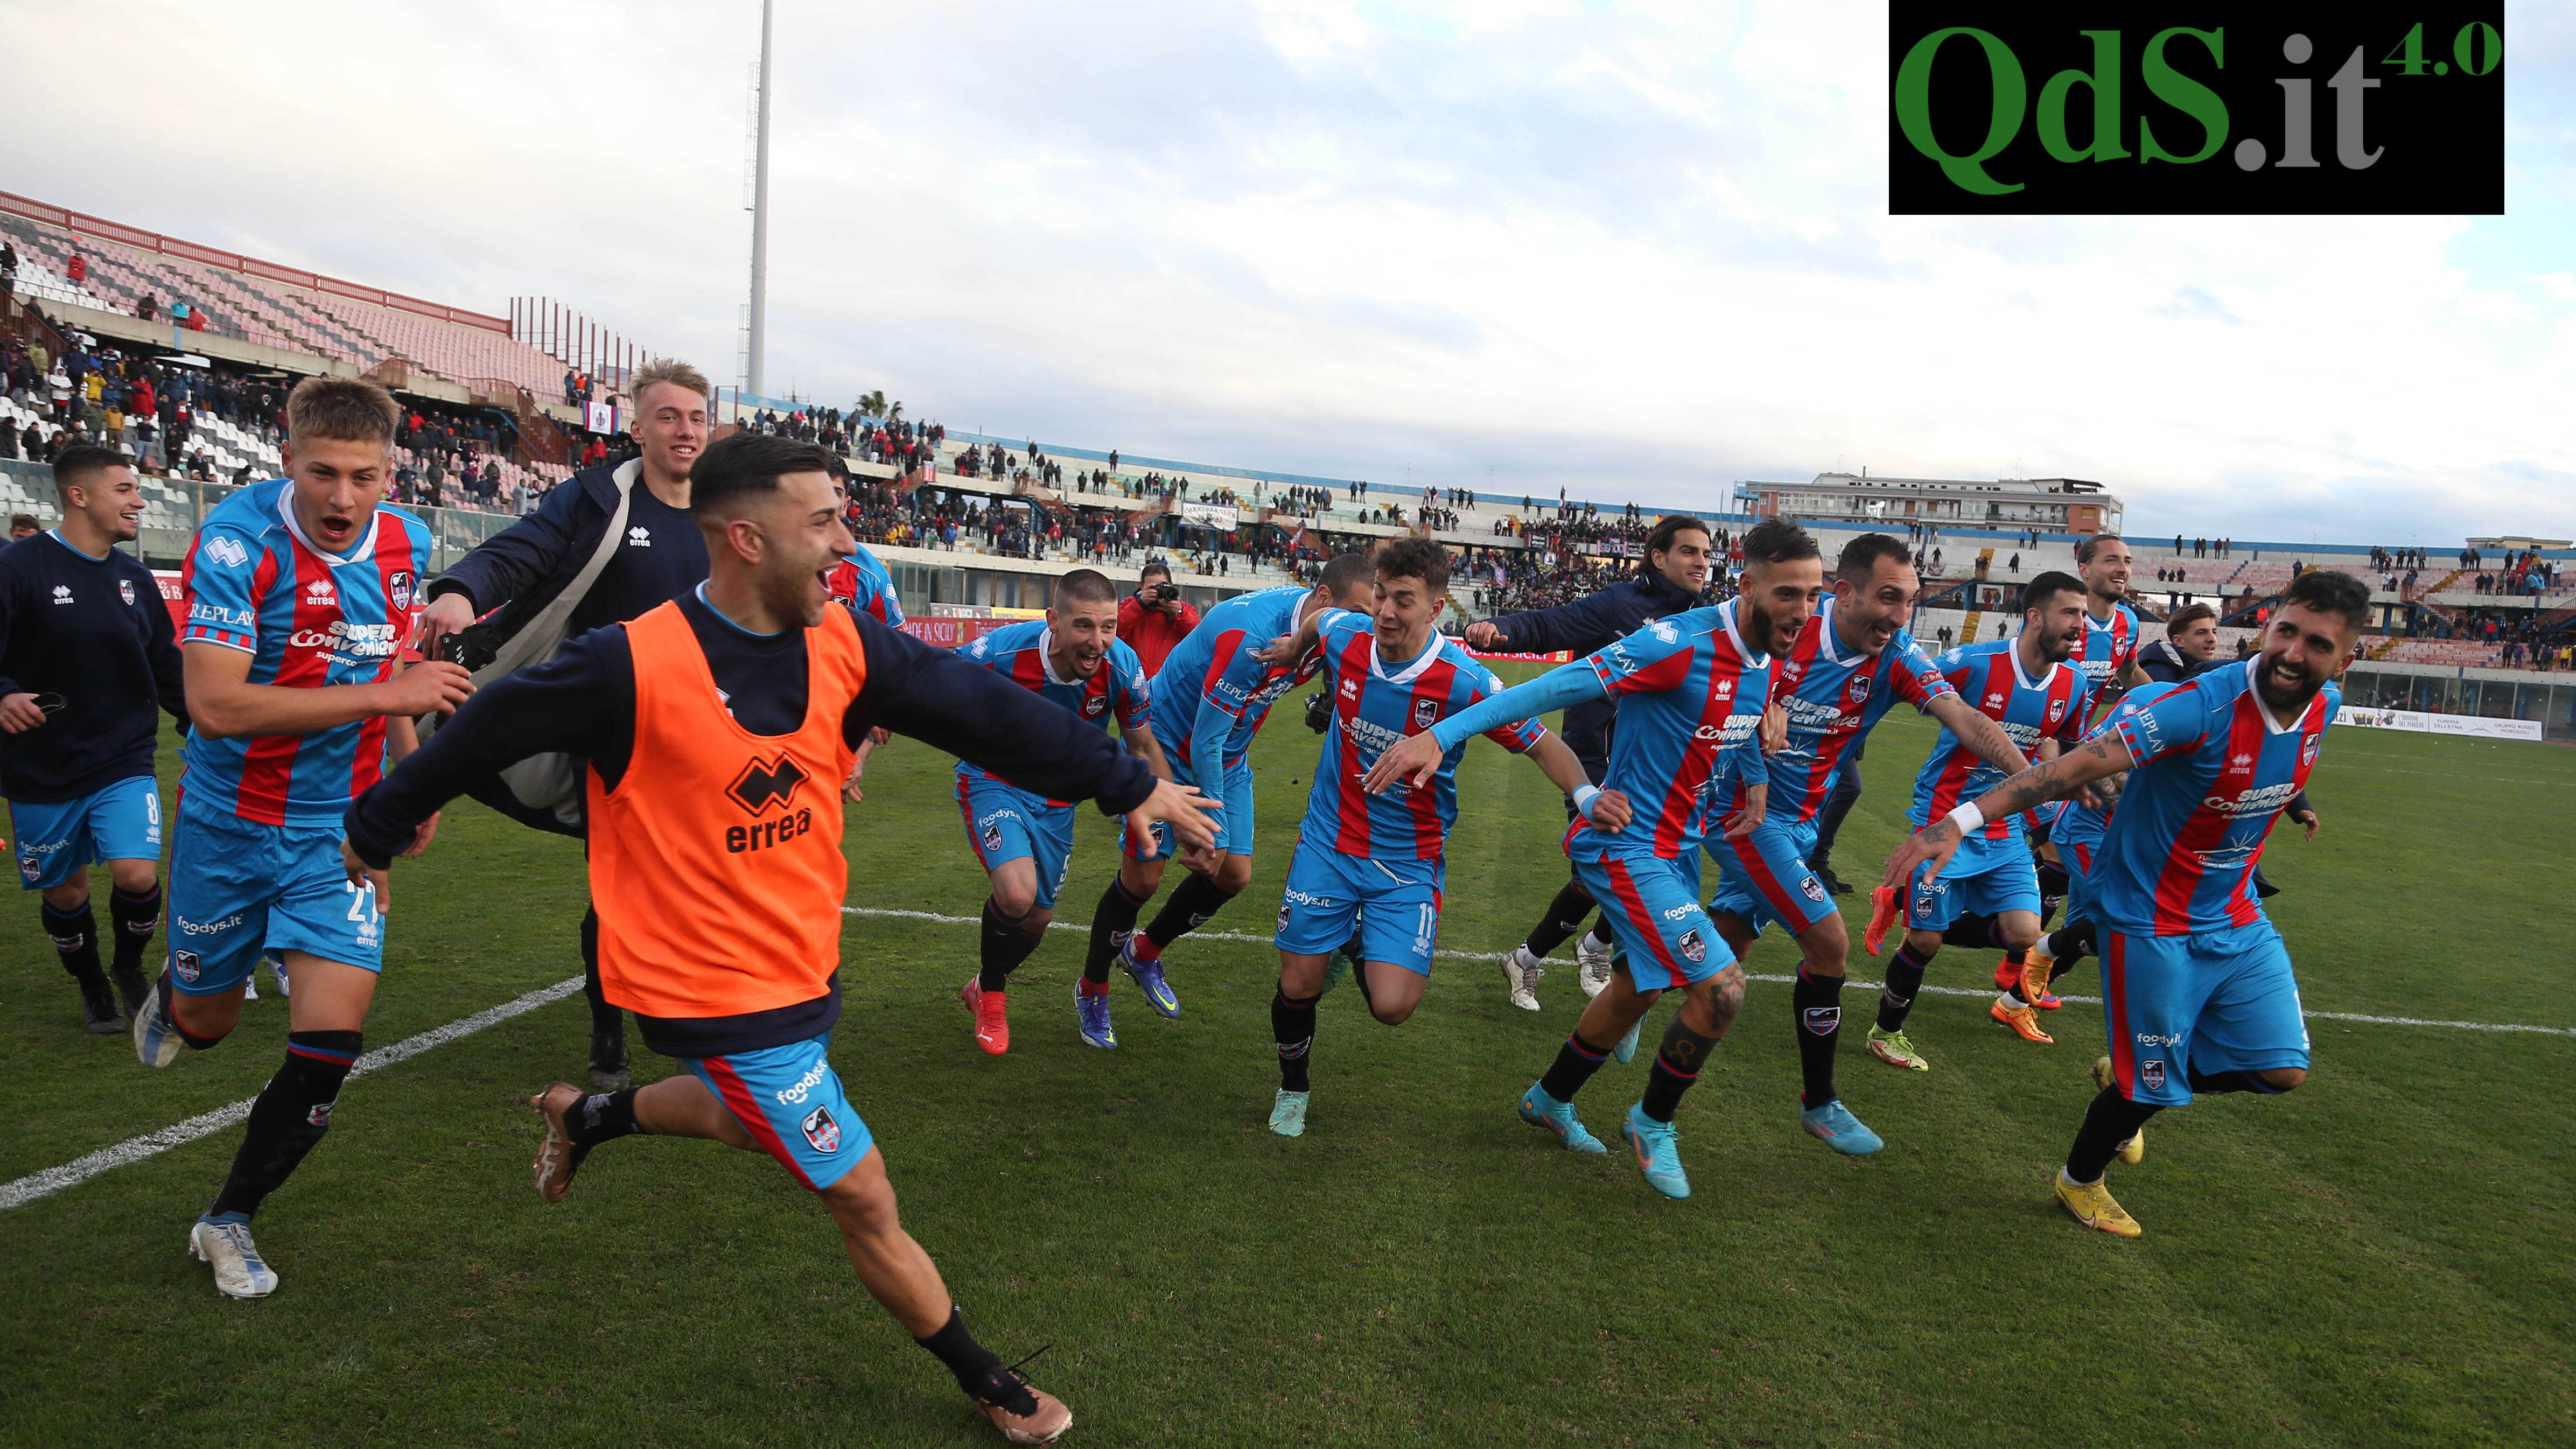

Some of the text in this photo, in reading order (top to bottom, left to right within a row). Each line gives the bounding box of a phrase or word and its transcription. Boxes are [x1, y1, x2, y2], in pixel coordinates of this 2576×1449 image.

[188, 603, 255, 626] REPLAY
[328, 621, 396, 641] SUPER
[1608, 641, 1638, 674] EPLAY
[2079, 660, 2112, 669] SUPER
[1215, 678, 1249, 702] REPLA
[1780, 694, 1841, 719] SUPER
[2137, 707, 2166, 753] REPLAY
[2237, 782, 2295, 802] SUPER
[146, 792, 159, 825] 8
[178, 915, 243, 935] foodys.it
[1418, 902, 1433, 939] 11
